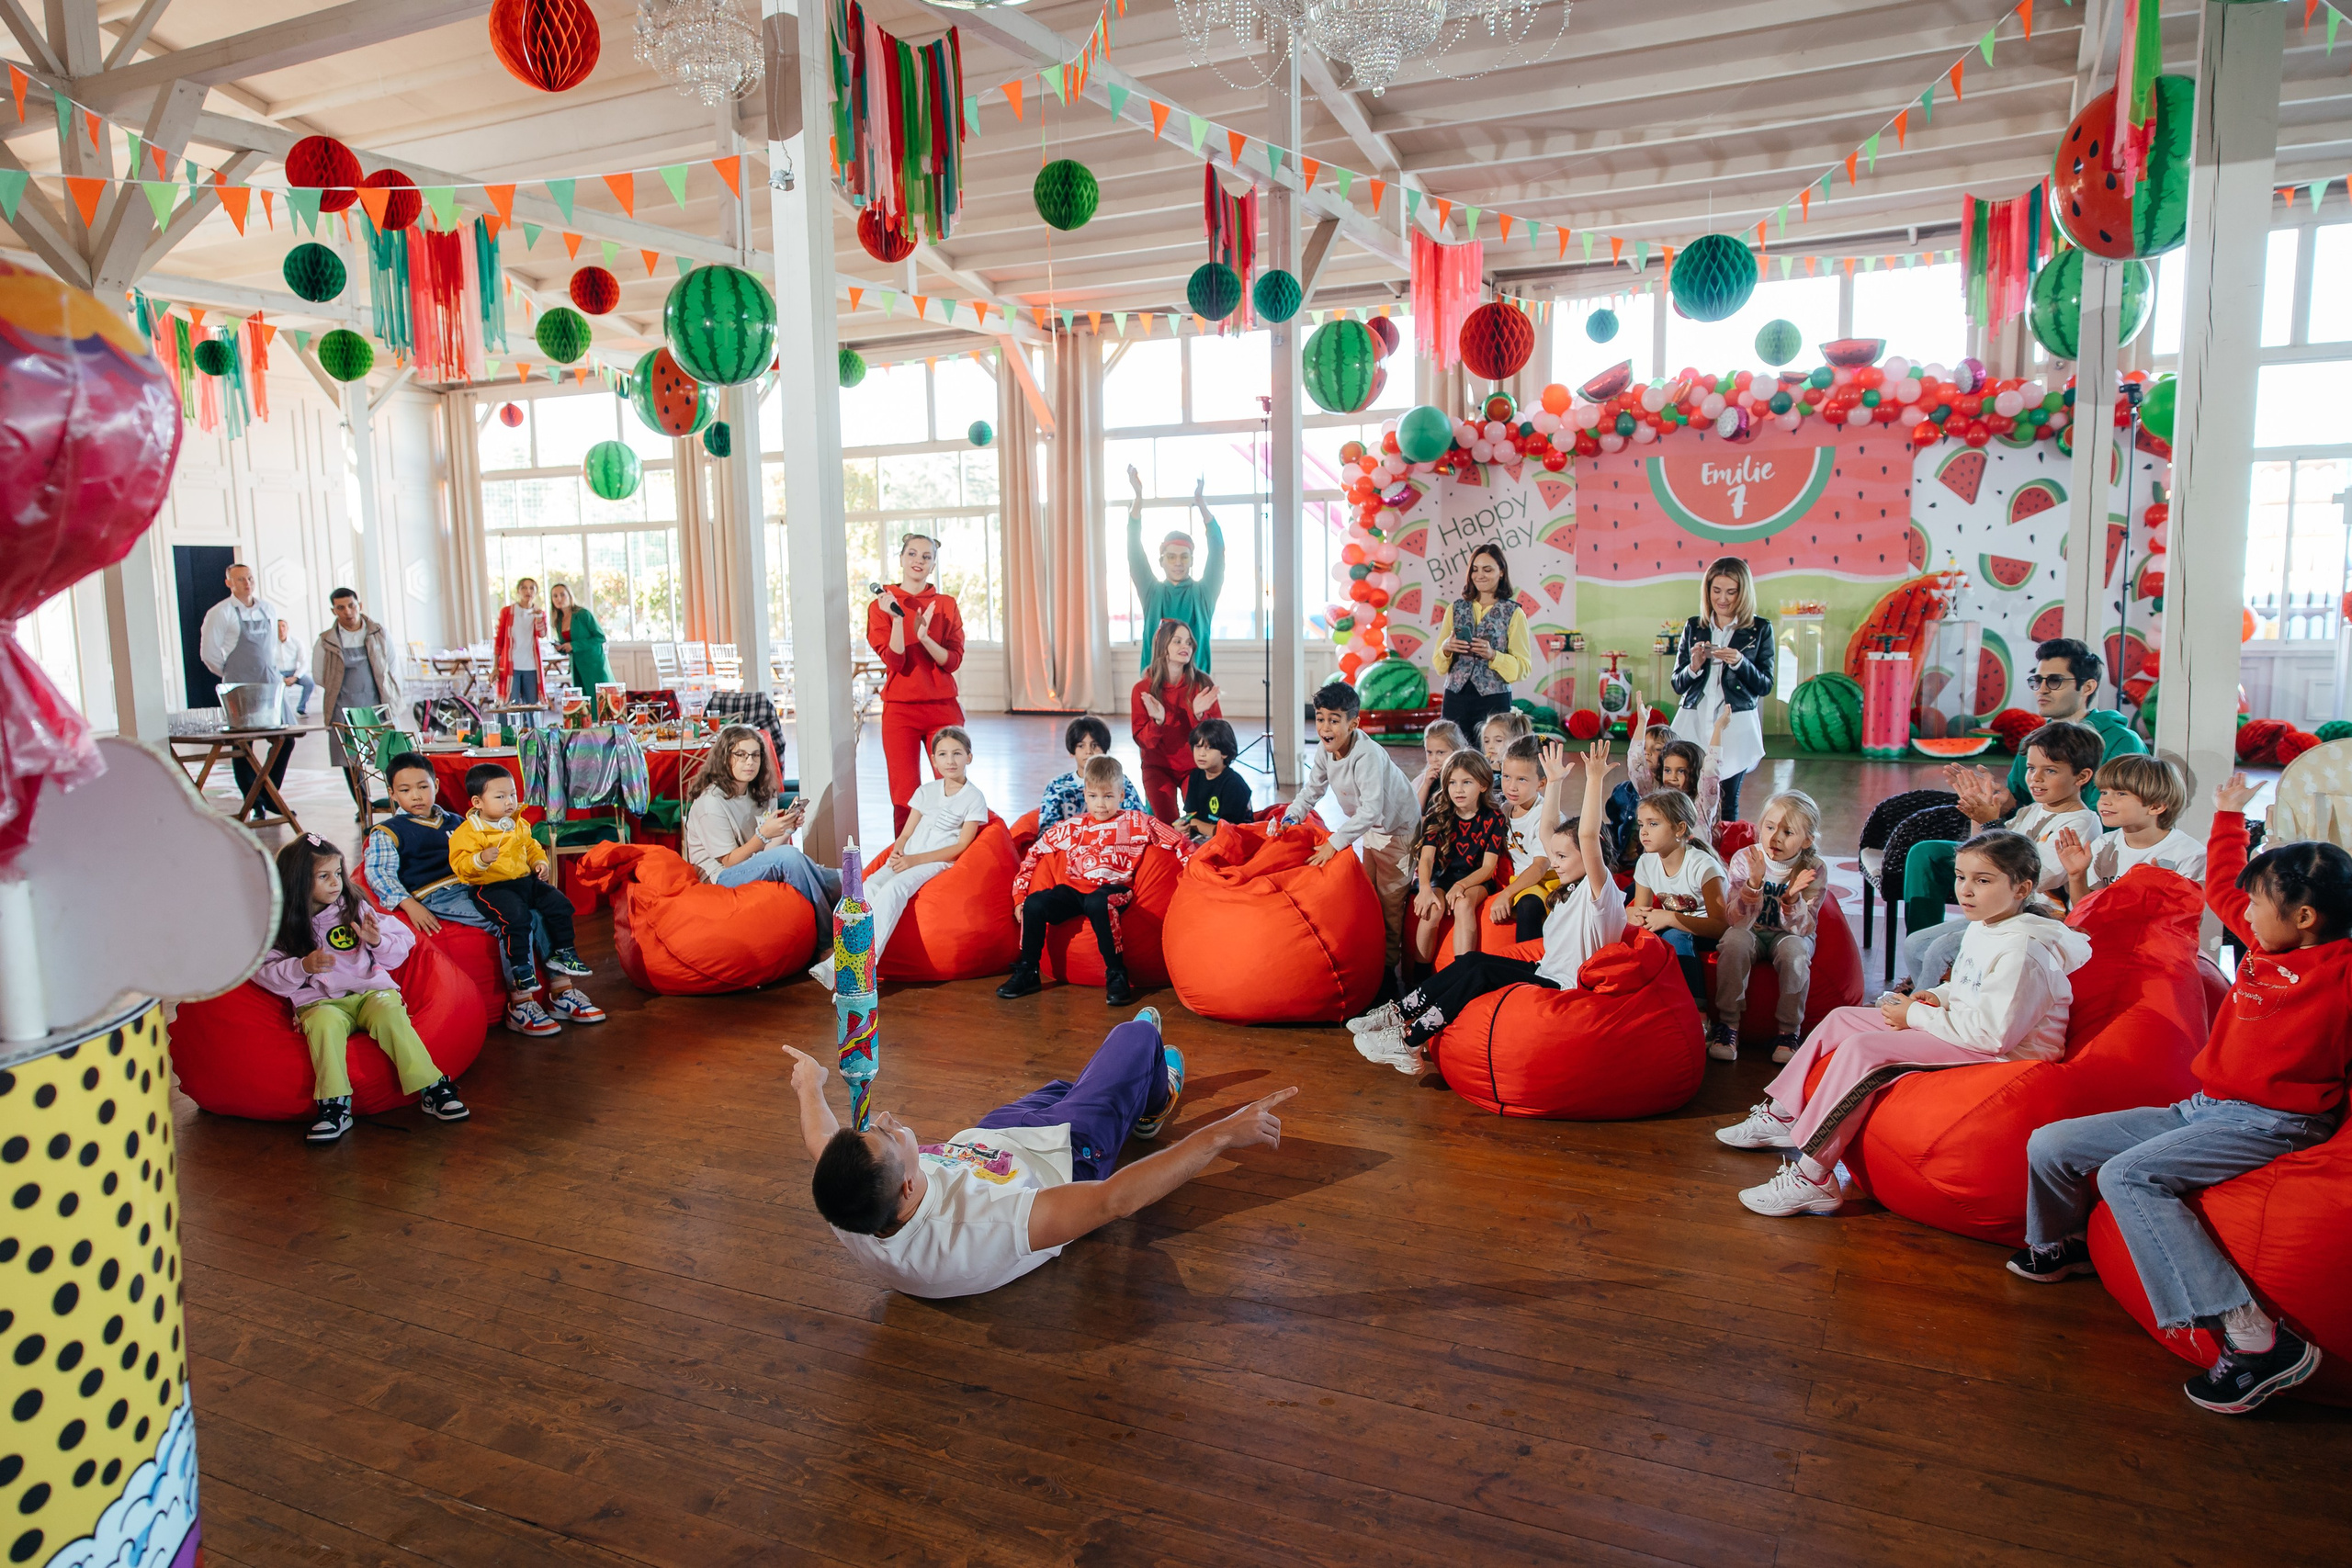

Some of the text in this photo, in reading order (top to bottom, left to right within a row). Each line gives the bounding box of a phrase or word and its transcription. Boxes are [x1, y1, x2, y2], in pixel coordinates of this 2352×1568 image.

[1702, 455, 1776, 486] Emilie
[1438, 491, 1527, 547] Happy
[1727, 483, 1748, 520] 7
